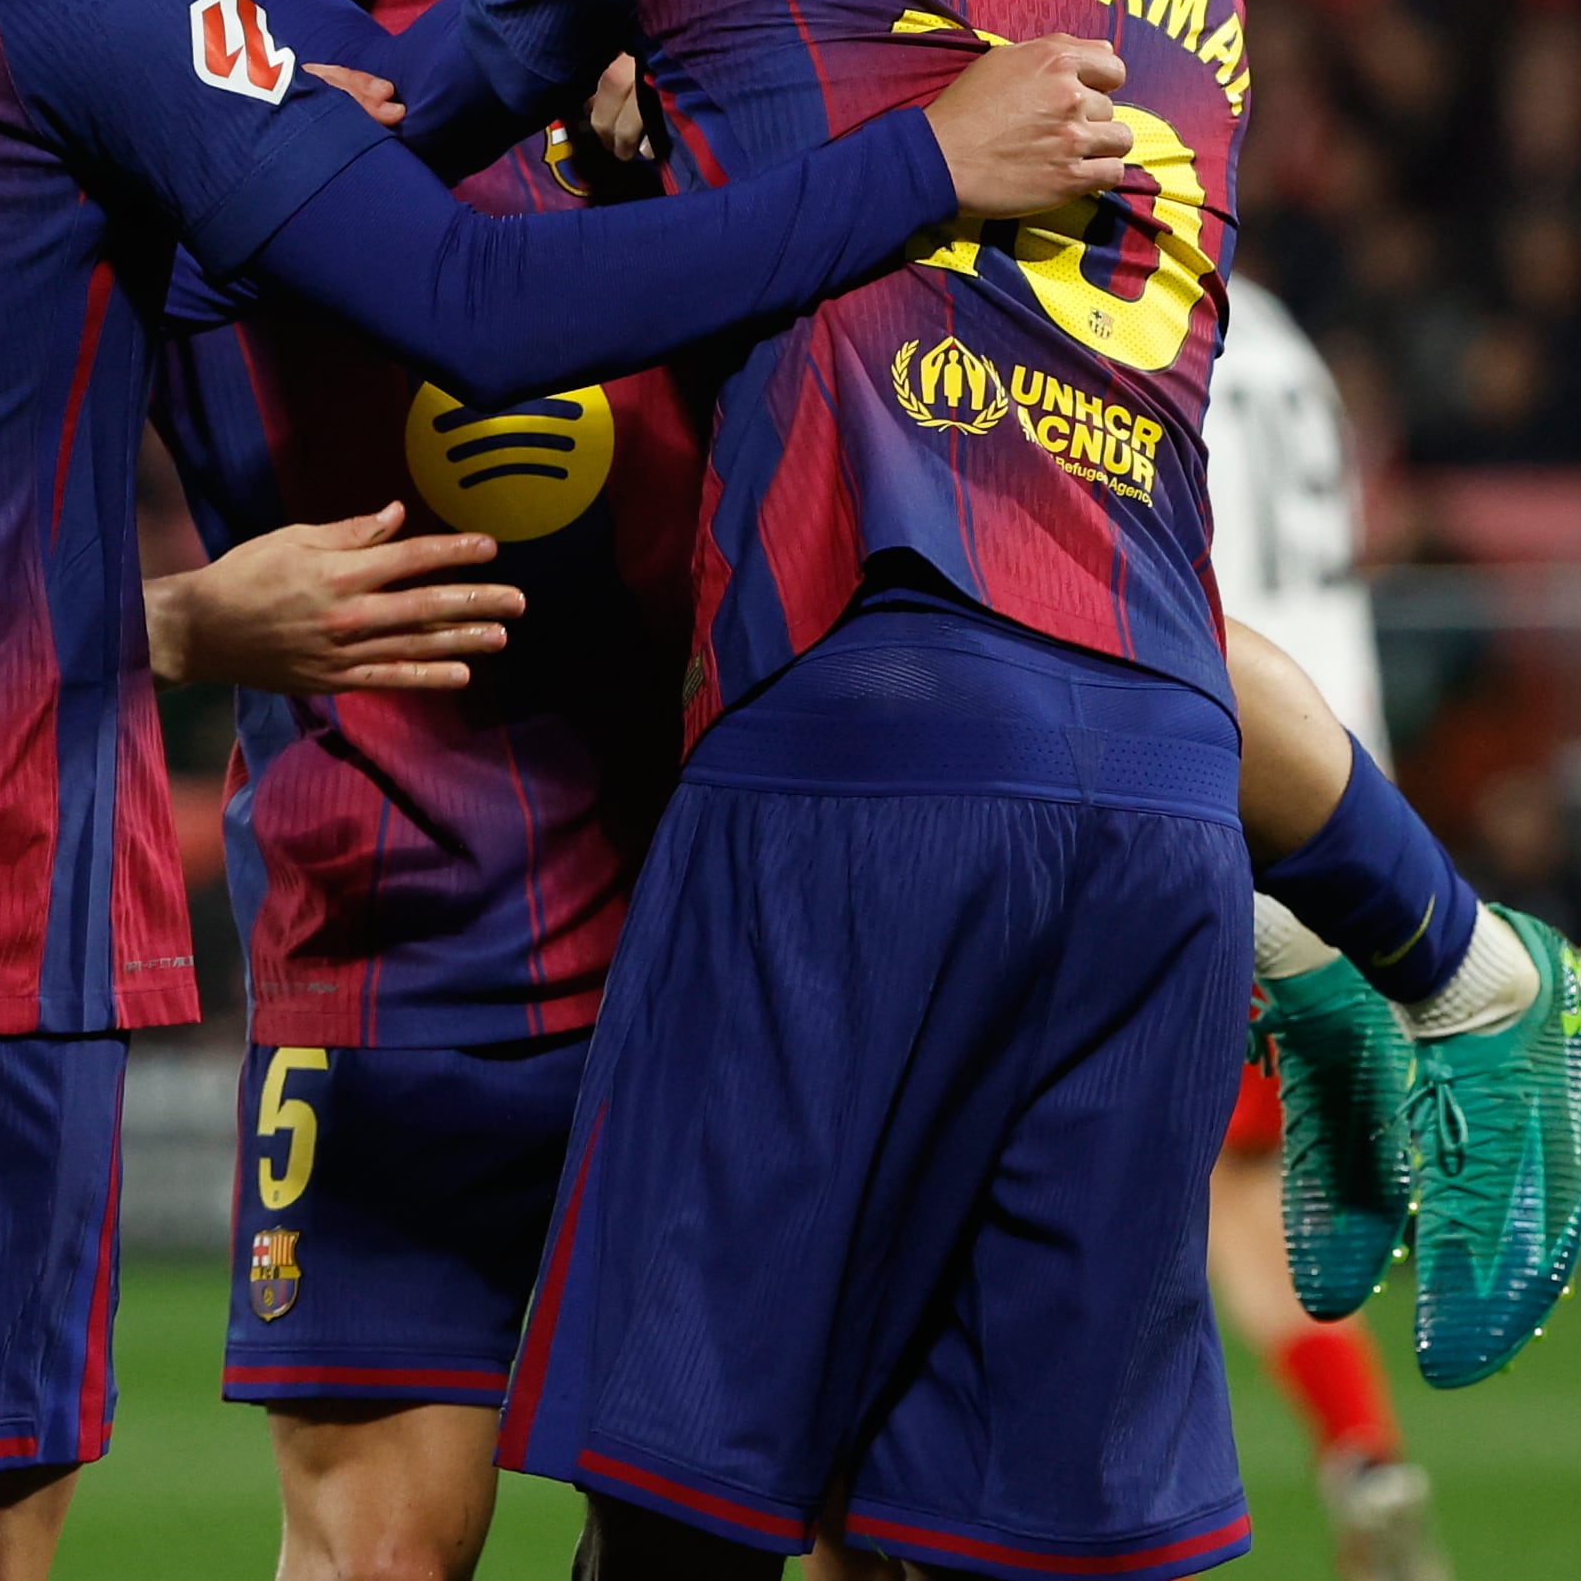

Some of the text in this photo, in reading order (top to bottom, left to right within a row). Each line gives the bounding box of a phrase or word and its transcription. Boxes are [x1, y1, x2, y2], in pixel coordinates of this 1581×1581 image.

[1010, 364, 1163, 460] UNHCR
[1017, 405, 1155, 494] ACNUR
[257, 1046, 329, 1210] 5
